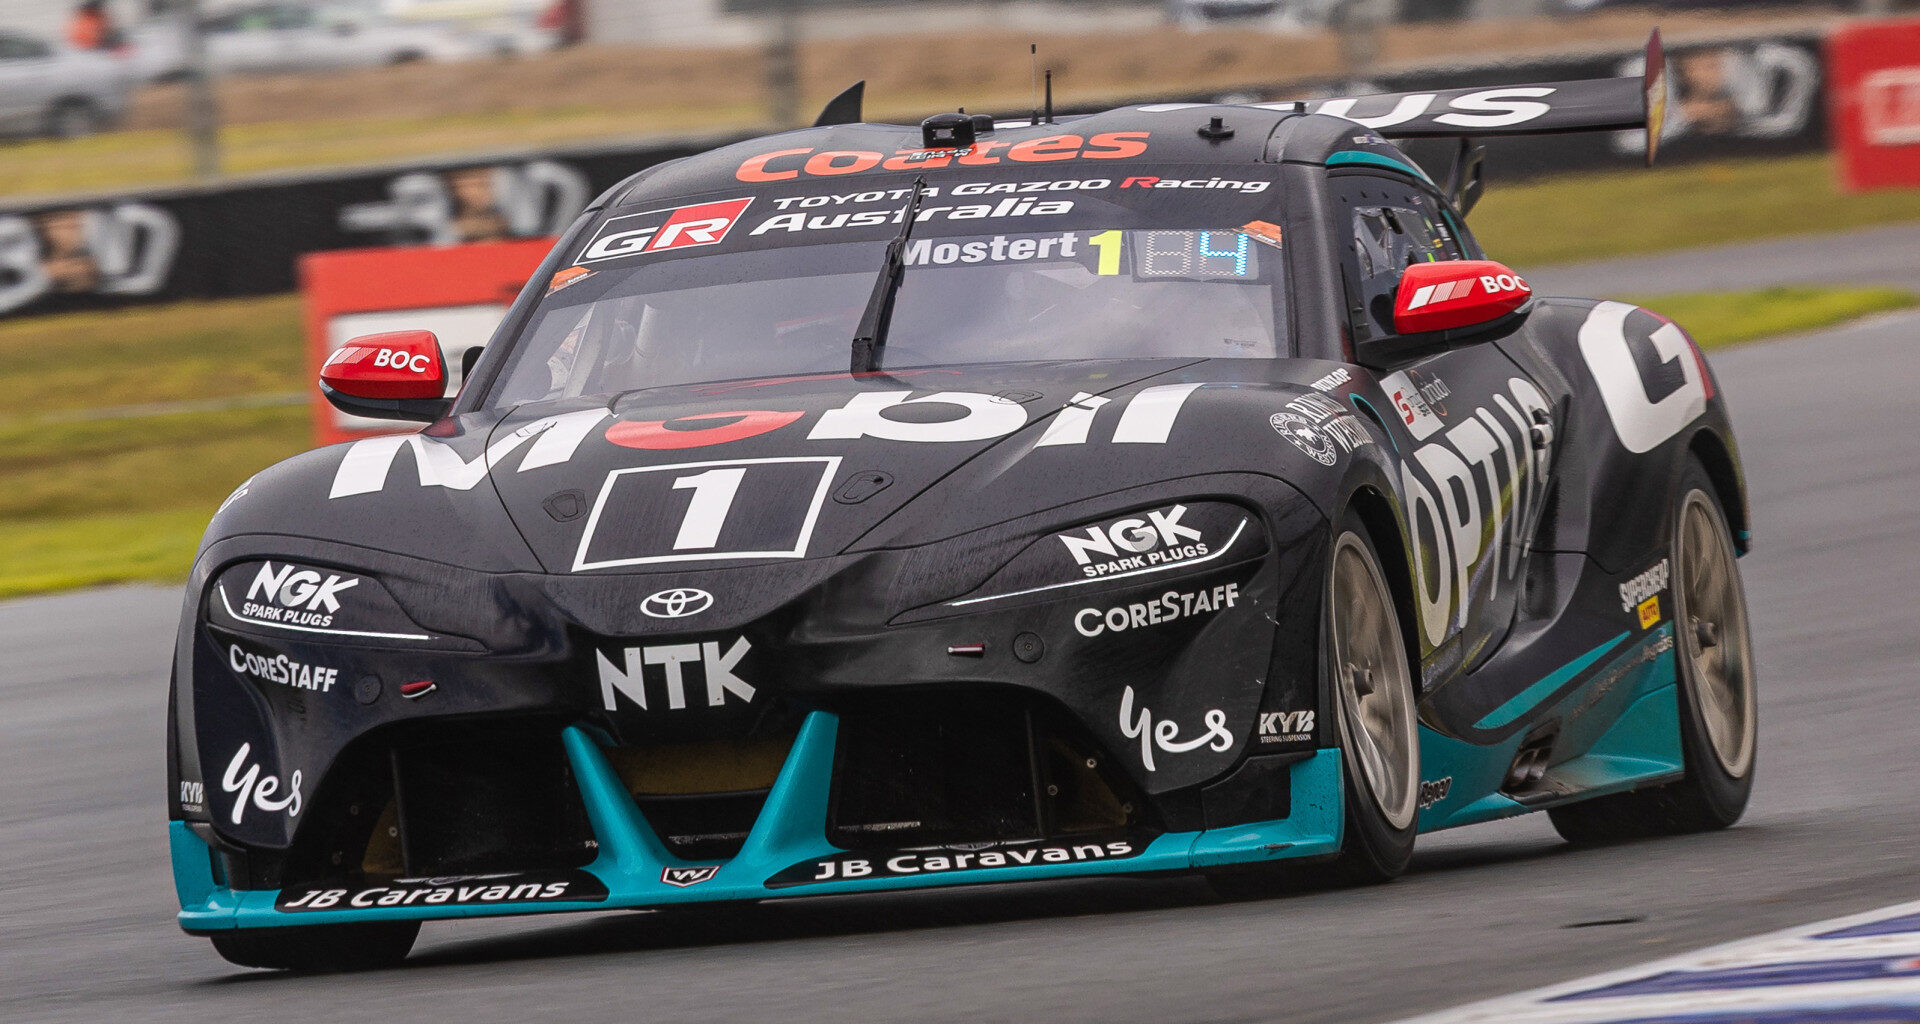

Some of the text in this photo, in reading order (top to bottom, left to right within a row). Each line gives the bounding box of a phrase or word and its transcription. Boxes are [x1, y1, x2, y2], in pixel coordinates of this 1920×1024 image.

[736, 131, 1151, 183] Coates
[773, 175, 1272, 210] TOYOTA GAZOO Racing
[749, 198, 1075, 236] Australia
[584, 215, 732, 260] GR
[902, 232, 1079, 268] Mostert
[1089, 230, 1122, 275] 1
[1480, 273, 1532, 293] BOC
[374, 347, 430, 373] BOC
[1310, 367, 1352, 392] DUNLOP
[328, 382, 1204, 500] Mobil
[671, 468, 746, 550] 1
[1058, 505, 1203, 566] NGK
[1083, 543, 1209, 578] SPARK PLUGS
[246, 560, 359, 615] NGK
[242, 602, 333, 627] SPARK PLUGS
[596, 635, 756, 711] NTK
[1119, 685, 1234, 771] yes
[1259, 710, 1315, 735] KYB
[222, 742, 302, 825] yes
[815, 839, 1133, 879] JB Caravans
[285, 880, 569, 908] JB Caravans
